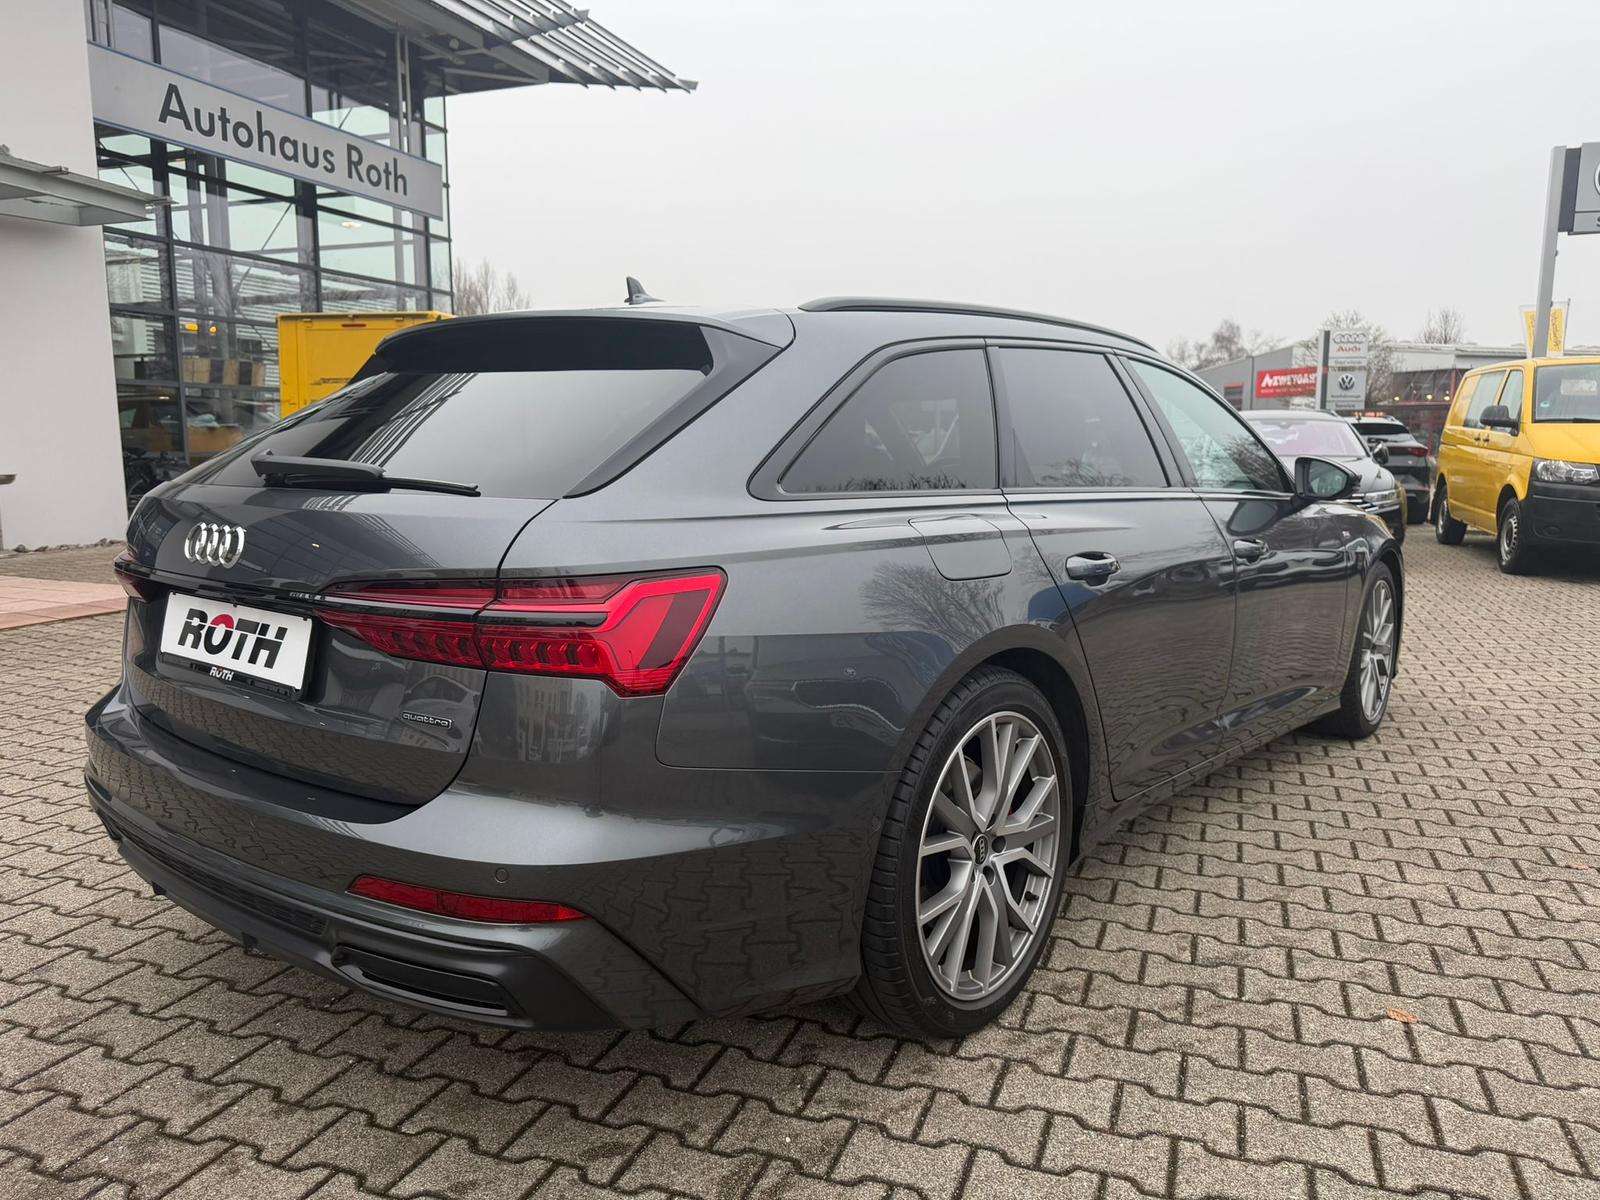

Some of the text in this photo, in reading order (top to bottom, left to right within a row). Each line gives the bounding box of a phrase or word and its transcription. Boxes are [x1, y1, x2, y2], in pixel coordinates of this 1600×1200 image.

[158, 83, 408, 196] Autohaus Roth
[1336, 345, 1361, 353] Audi
[178, 608, 288, 669] ROTH
[209, 666, 234, 681] ROTH
[402, 713, 449, 726] quattro
